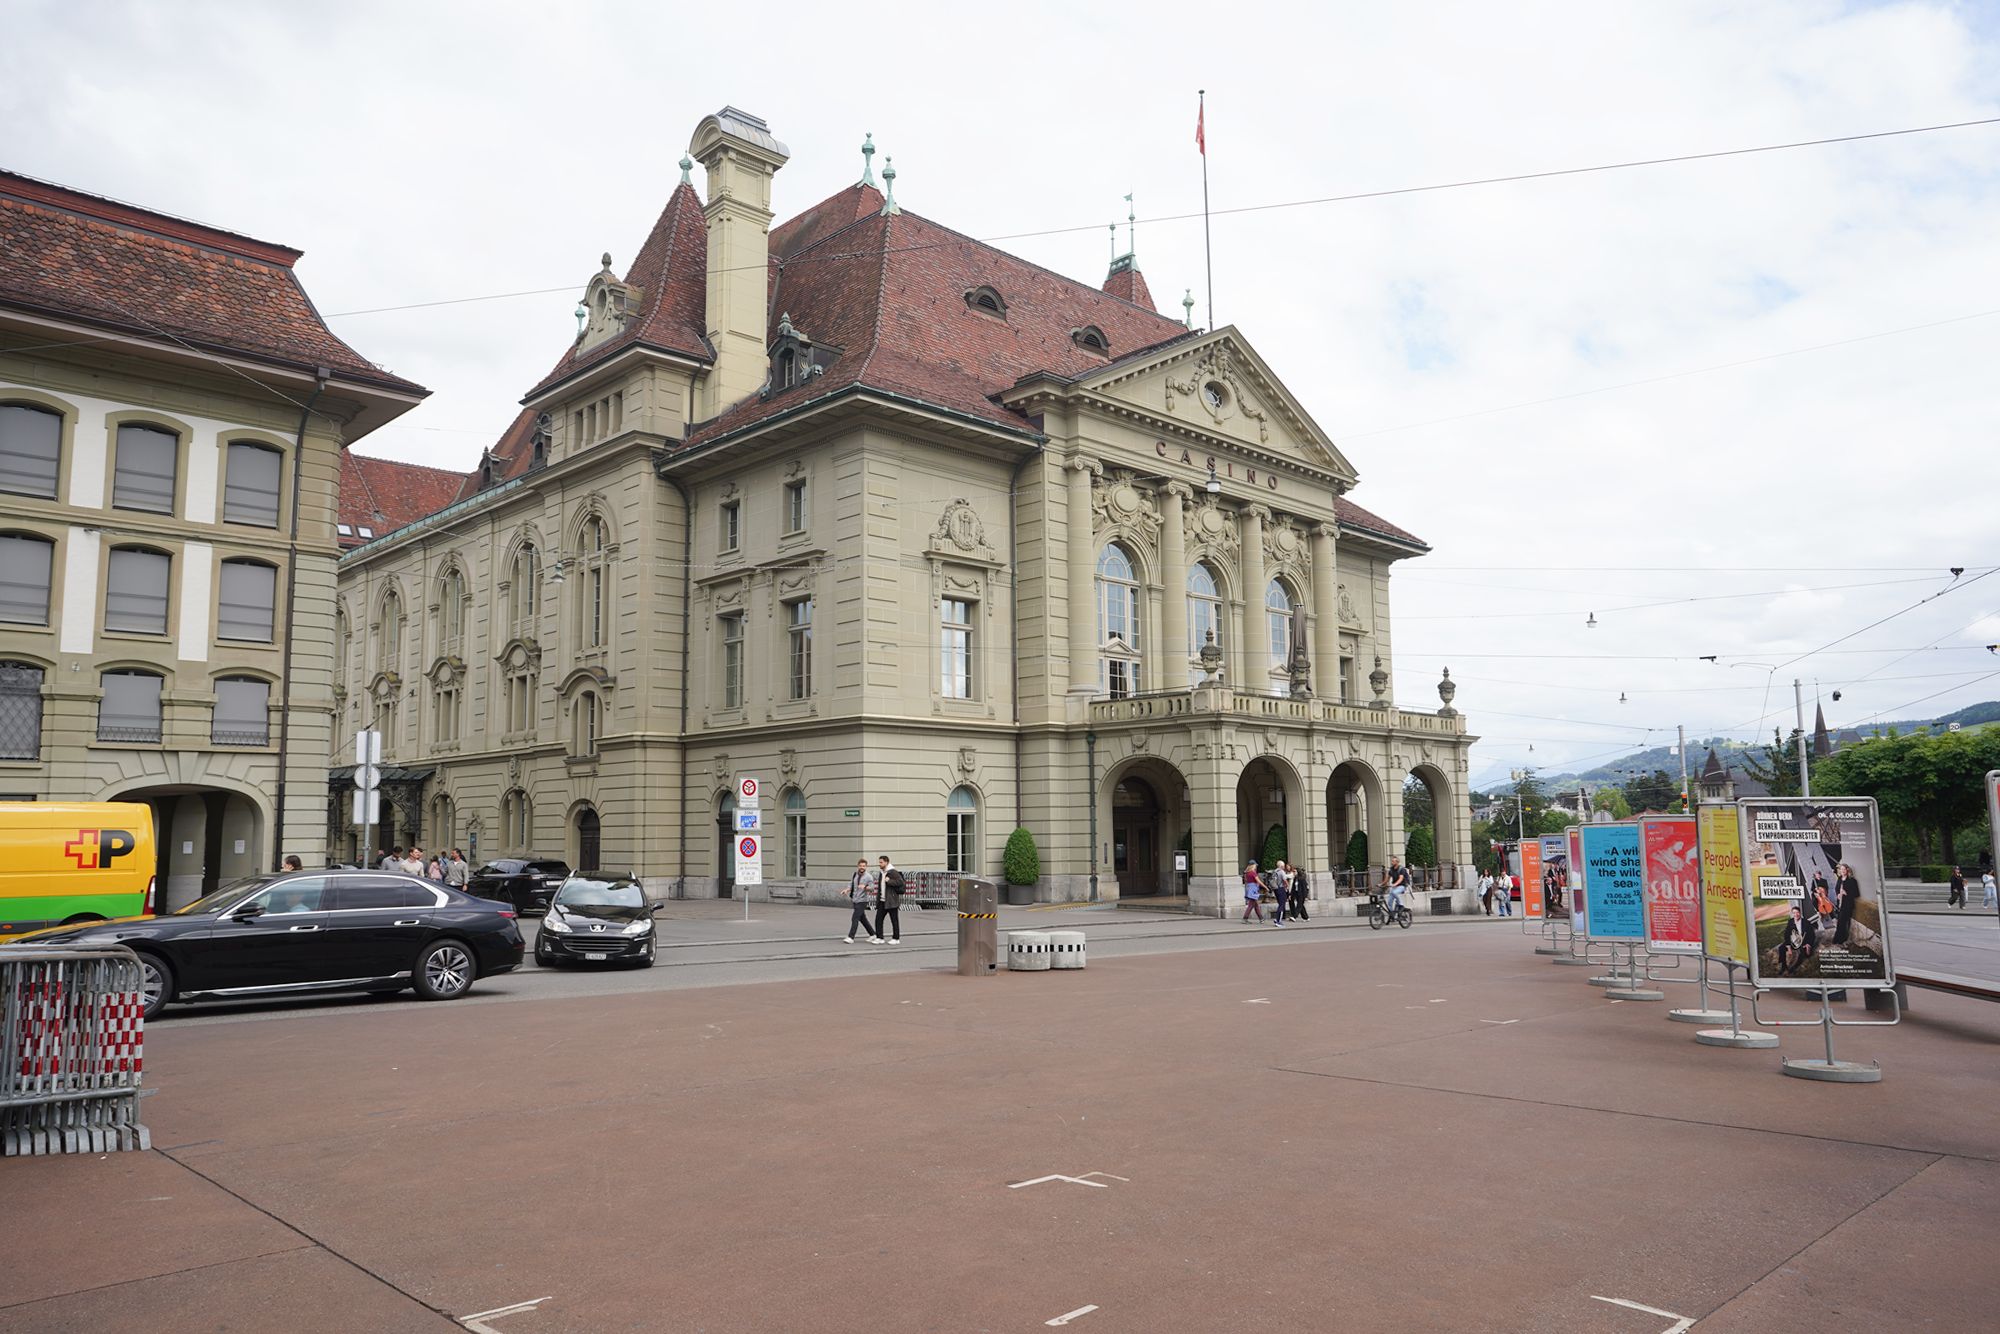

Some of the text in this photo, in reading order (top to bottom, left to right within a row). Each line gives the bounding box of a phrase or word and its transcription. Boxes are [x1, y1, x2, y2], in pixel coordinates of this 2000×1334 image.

[1156, 441, 1278, 490] CASINO
[1757, 822, 1778, 831] BERNER
[1758, 831, 1819, 840] SYMPHONIEORCHESTER
[1604, 846, 1640, 856] «A wil
[1590, 857, 1641, 867] wind sha
[1598, 868, 1617, 877] the
[1613, 880, 1639, 888] sea»
[1762, 879, 1795, 887] BRUCKNERS
[1648, 874, 1700, 903] solo
[1706, 879, 1745, 900] Arnesen
